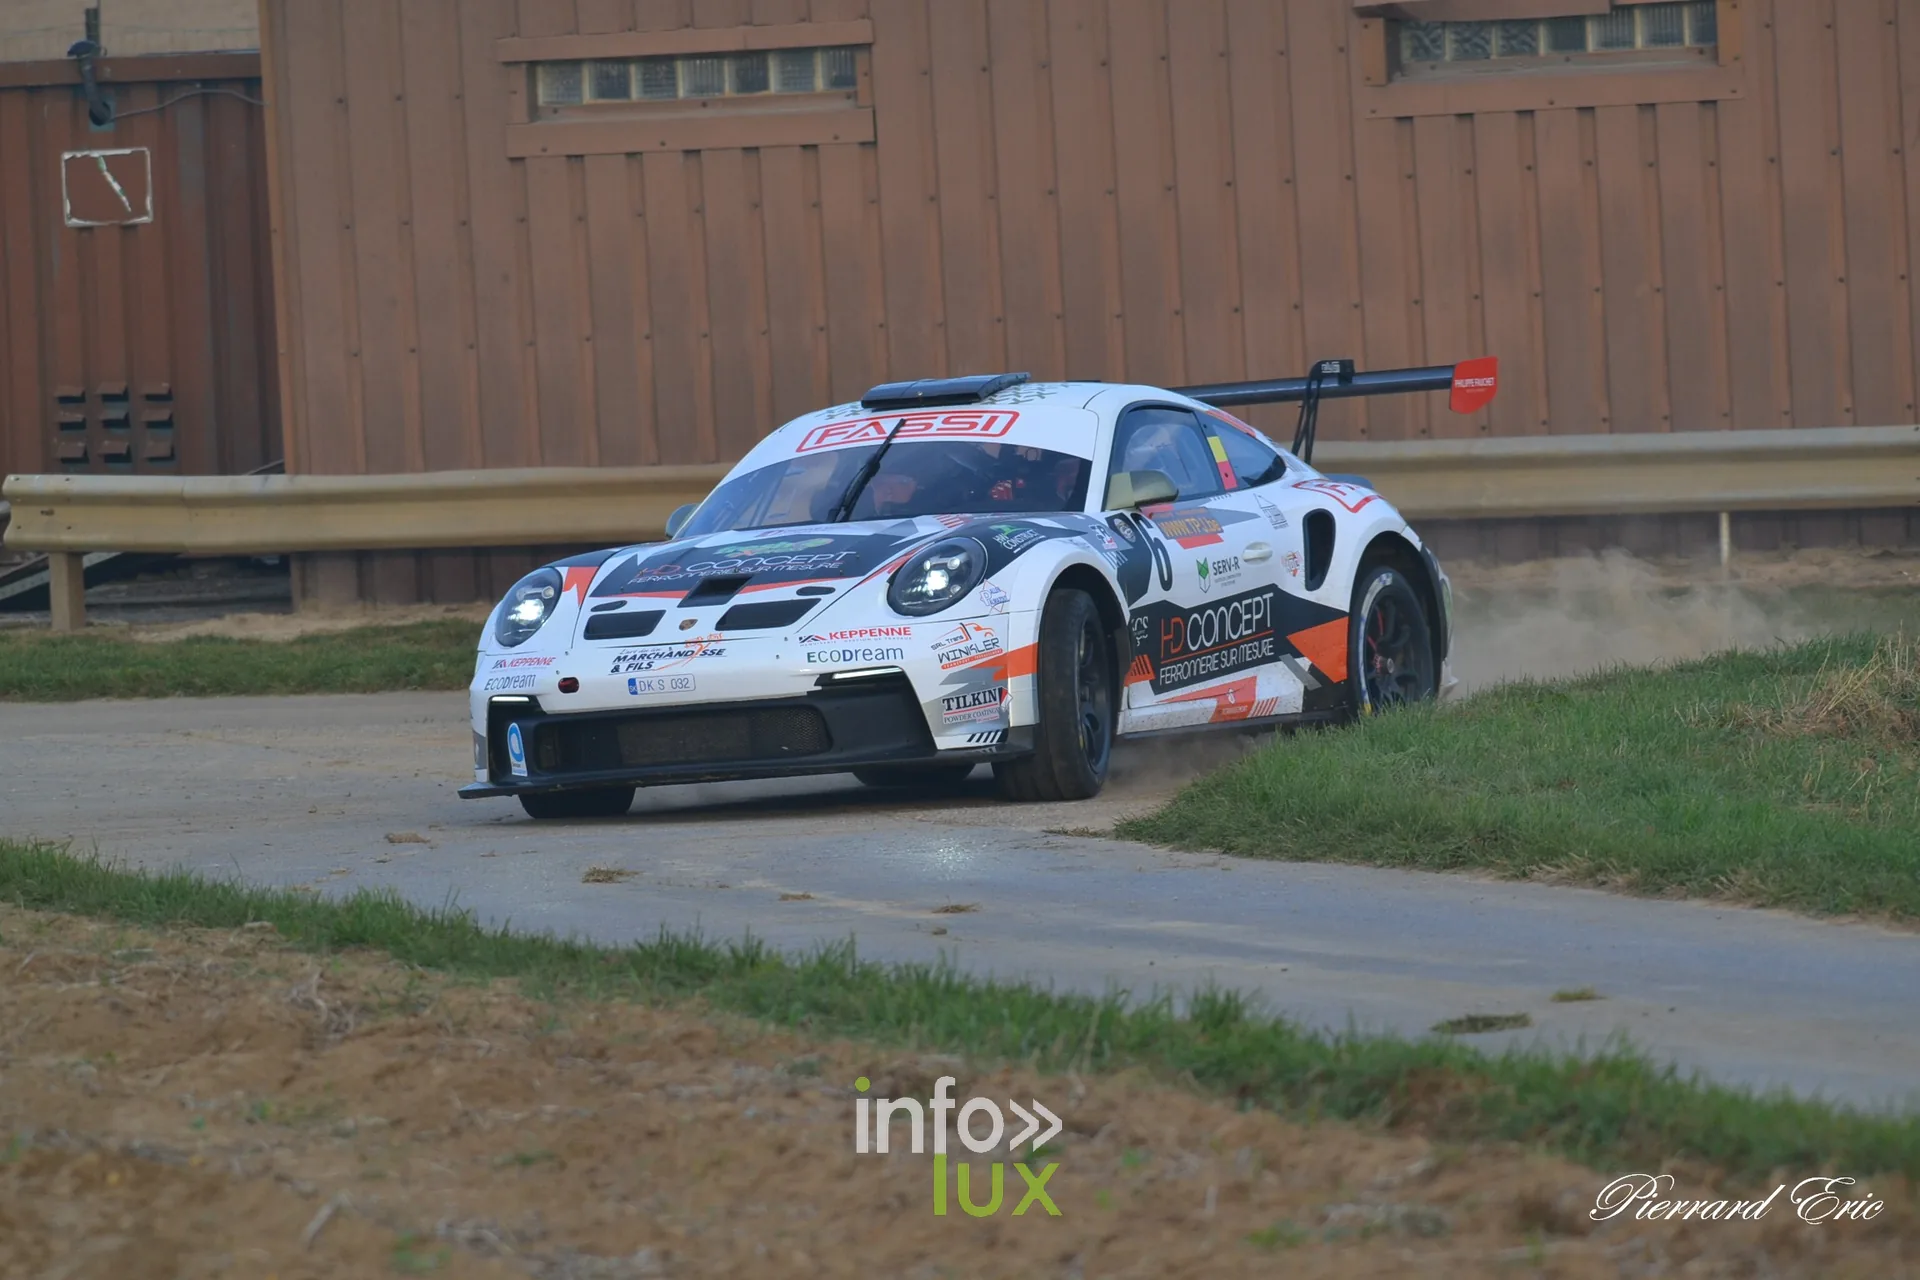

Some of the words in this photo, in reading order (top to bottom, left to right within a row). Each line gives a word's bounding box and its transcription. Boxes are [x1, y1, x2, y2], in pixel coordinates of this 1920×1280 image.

[814, 414, 999, 445] FASSI
[1212, 556, 1240, 576] SERV-R
[829, 627, 912, 640] KEPPENNE
[1160, 616, 1186, 659] HD
[938, 637, 1001, 664] WINKLER
[1220, 648, 1238, 668] SUR
[1238, 637, 1275, 663] MESURE
[508, 656, 556, 668] KEPPENNE
[611, 664, 621, 674] &
[625, 661, 655, 672] FILS
[639, 680, 655, 692] DK
[657, 679, 665, 691] S
[671, 677, 690, 690] 032
[942, 688, 998, 712] TILKIN
[944, 714, 972, 724] POWDER
